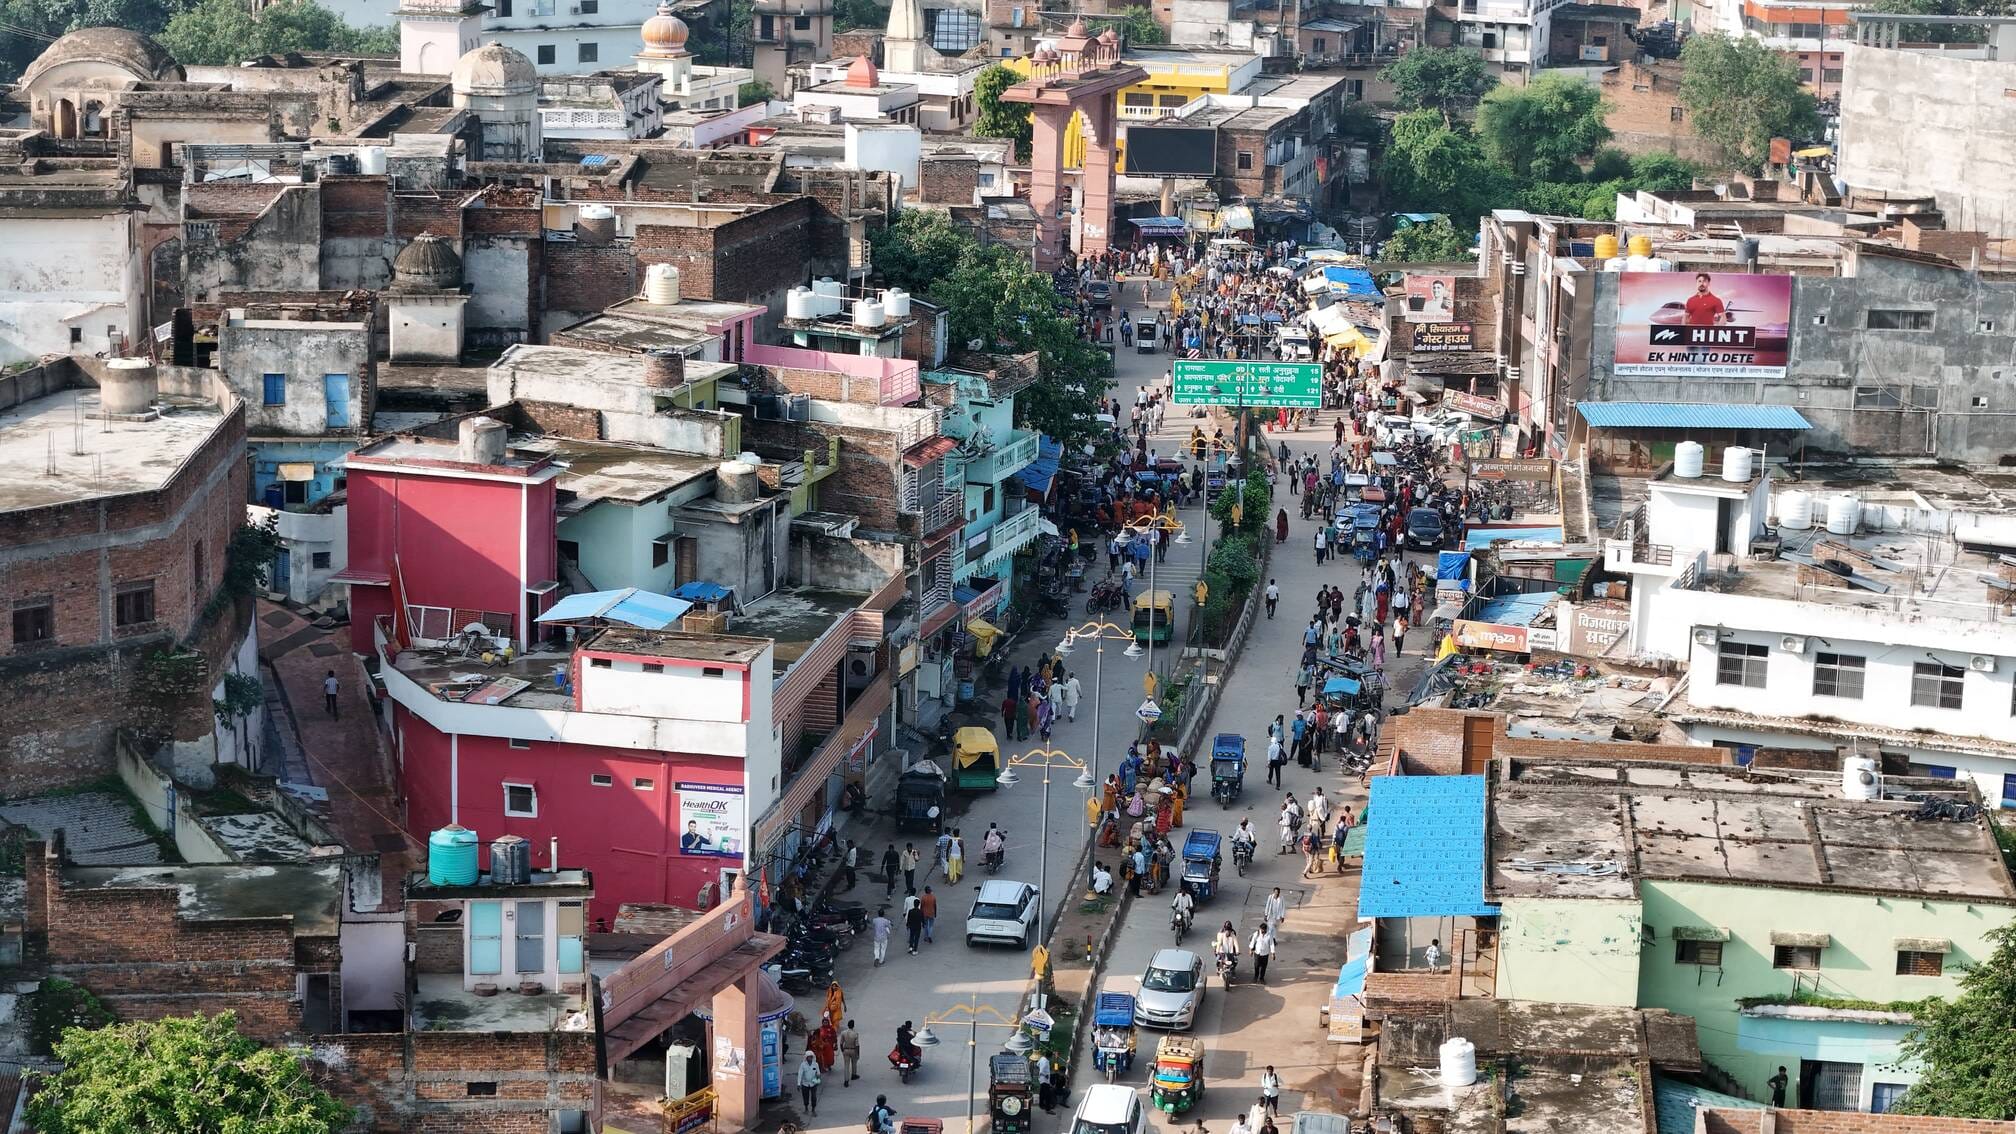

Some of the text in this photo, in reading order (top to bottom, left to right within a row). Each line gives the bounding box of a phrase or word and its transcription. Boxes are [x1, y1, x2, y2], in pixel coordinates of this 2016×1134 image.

[1430, 324, 1461, 333] सियाराम
[1422, 333, 1469, 344] गेस्ट हाउस
[1692, 329, 1748, 343] HINT
[1648, 352, 1754, 363] EK HINT TO DETE
[1480, 631, 1515, 644] maaza
[682, 800, 729, 810] HealthOK
